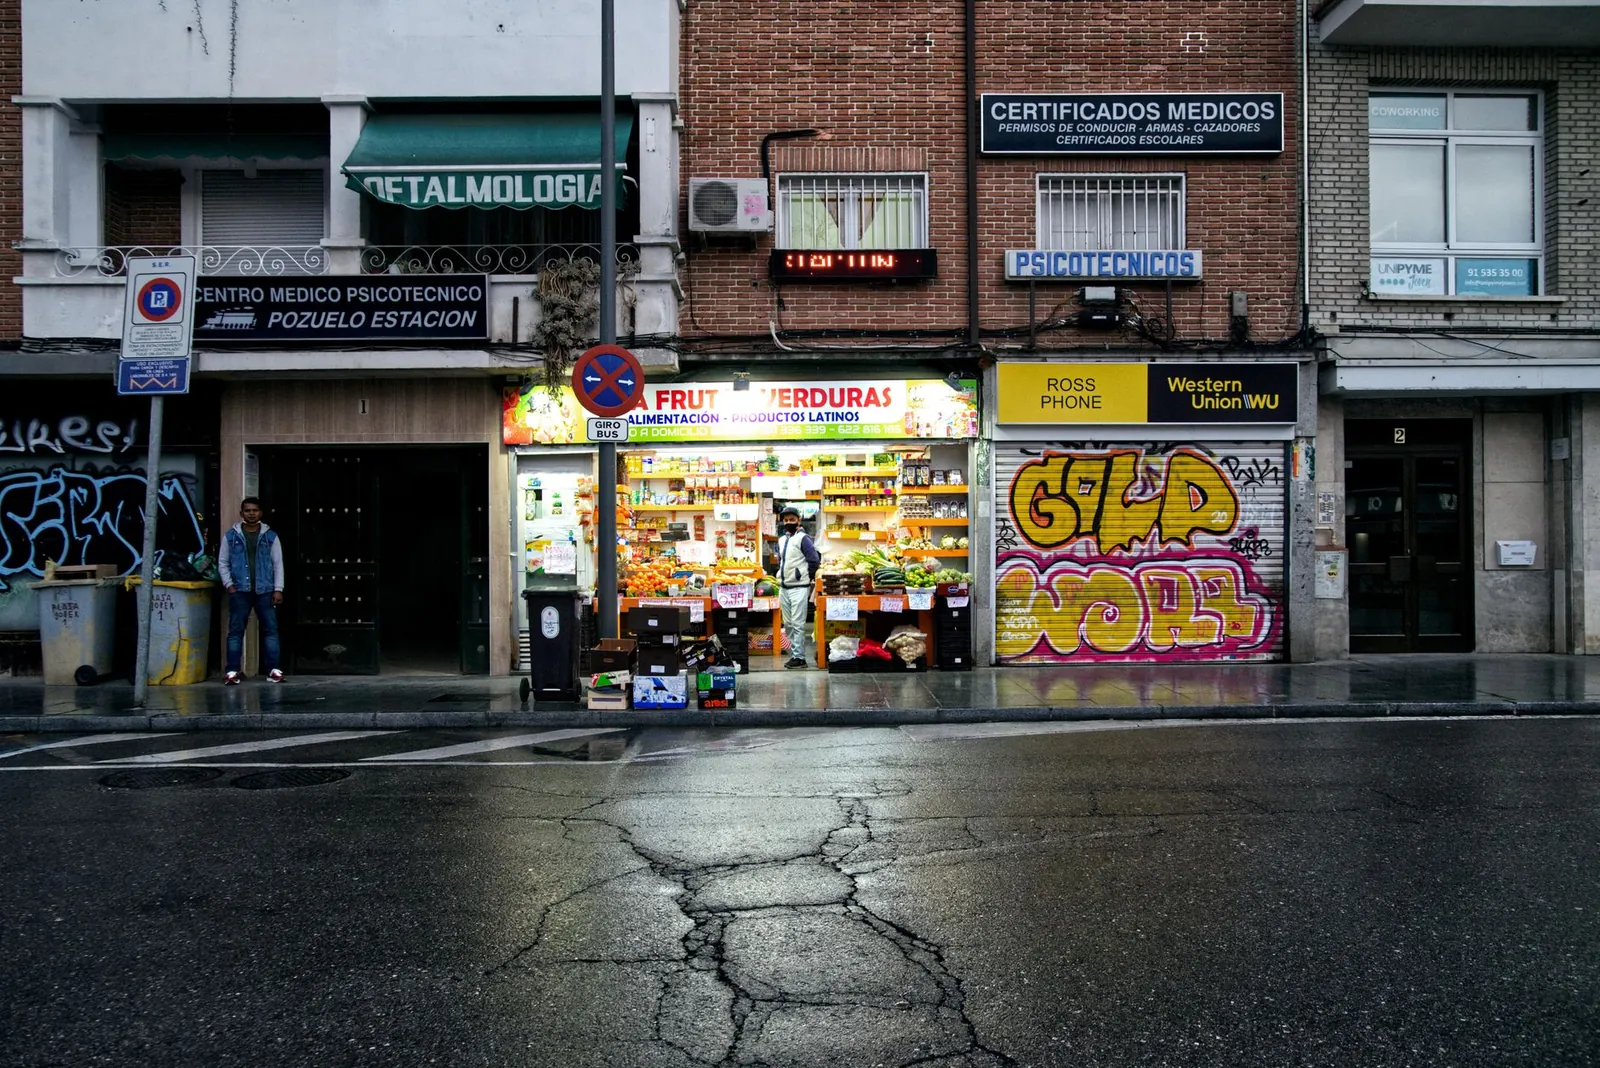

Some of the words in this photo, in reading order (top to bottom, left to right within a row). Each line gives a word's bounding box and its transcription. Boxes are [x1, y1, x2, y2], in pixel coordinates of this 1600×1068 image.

[990, 102, 1161, 121] CERTIFICADOS
[1168, 102, 1276, 120] MEDICOS
[1372, 108, 1440, 117] COWORKING
[998, 123, 1056, 132] PERMISOS
[1058, 123, 1074, 132] DE
[1076, 123, 1137, 132] CONDUCIR
[1145, 123, 1184, 132] ARMAS
[1194, 123, 1261, 132] CAZADORES
[1056, 135, 1136, 145] CERTIFICADOS
[1139, 135, 1204, 145] ESCOLARES
[1016, 252, 1194, 276] PSICOTECNICOS
[1378, 264, 1432, 274] UNIPYME
[1467, 268, 1479, 277] 91
[1480, 268, 1497, 277] 535
[1498, 268, 1510, 277] 35
[1512, 268, 1523, 277] 00
[270, 287, 341, 302] MEDICO
[347, 286, 482, 302] PSICOTECNICO
[267, 311, 365, 329] POZUELO
[370, 310, 478, 328] ESTACION
[1047, 378, 1096, 392] ROSS
[1168, 377, 1242, 392] Western
[360, 400, 367, 414] 1
[1041, 395, 1102, 409] PHONE
[1192, 394, 1241, 409] Union
[629, 411, 719, 425] ALIMENTACIÓN
[732, 412, 805, 422] PRODUCTOS
[808, 411, 860, 422] LATINOS
[595, 421, 620, 430] GIRO
[640, 428, 648, 437] A
[652, 428, 708, 436] DOMICILIO
[838, 425, 860, 434] 622
[597, 430, 619, 438] BUS
[1396, 430, 1404, 442] 2
